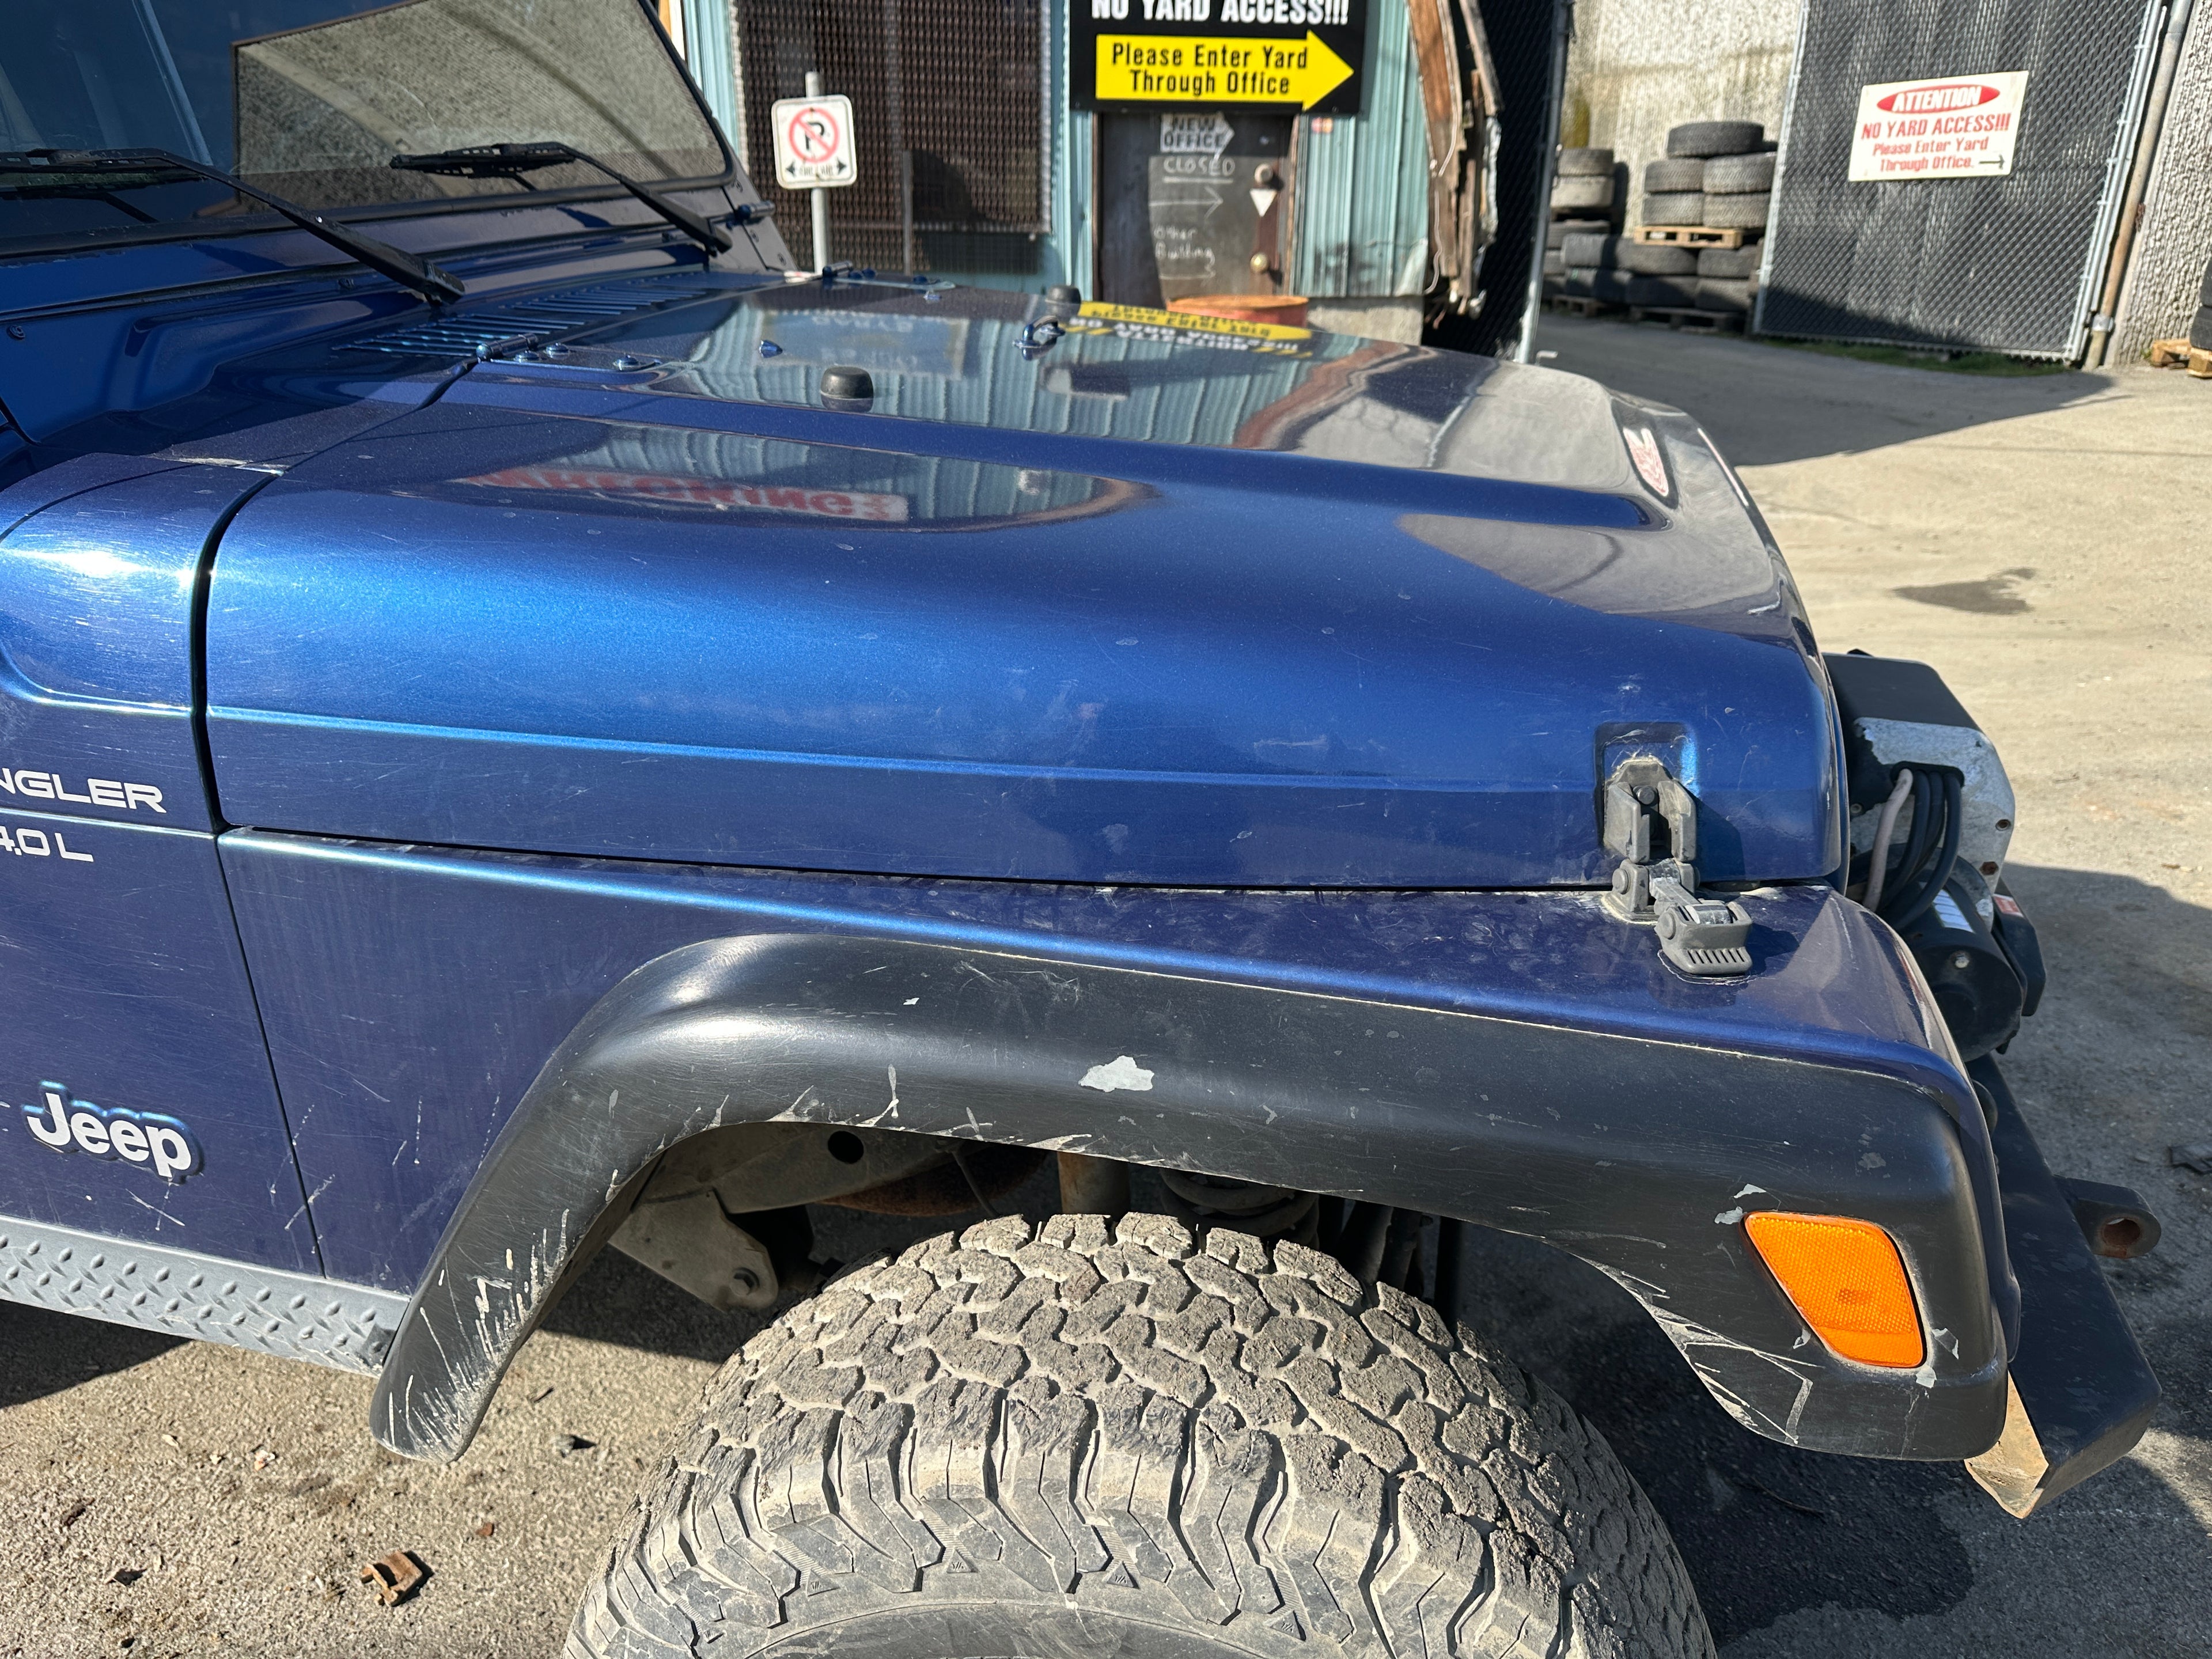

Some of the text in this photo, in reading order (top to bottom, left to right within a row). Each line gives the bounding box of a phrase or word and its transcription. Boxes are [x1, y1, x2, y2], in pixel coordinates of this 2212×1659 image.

[1091, 0, 1349, 25] NO YARD ACCESS!!!
[1112, 43, 1308, 69] Please Enter Yard
[1130, 69, 1290, 96] Through Office
[1892, 86, 1982, 112] ATTENTION
[1861, 113, 2011, 139] NO YARD ACCESS!!!
[1164, 131, 1222, 148] OFFICE
[1873, 136, 1990, 157] Please Enter Yard
[1163, 156, 1236, 176] CLOSED
[1880, 156, 1928, 172] Through
[26, 1092, 192, 1178] Jeep
